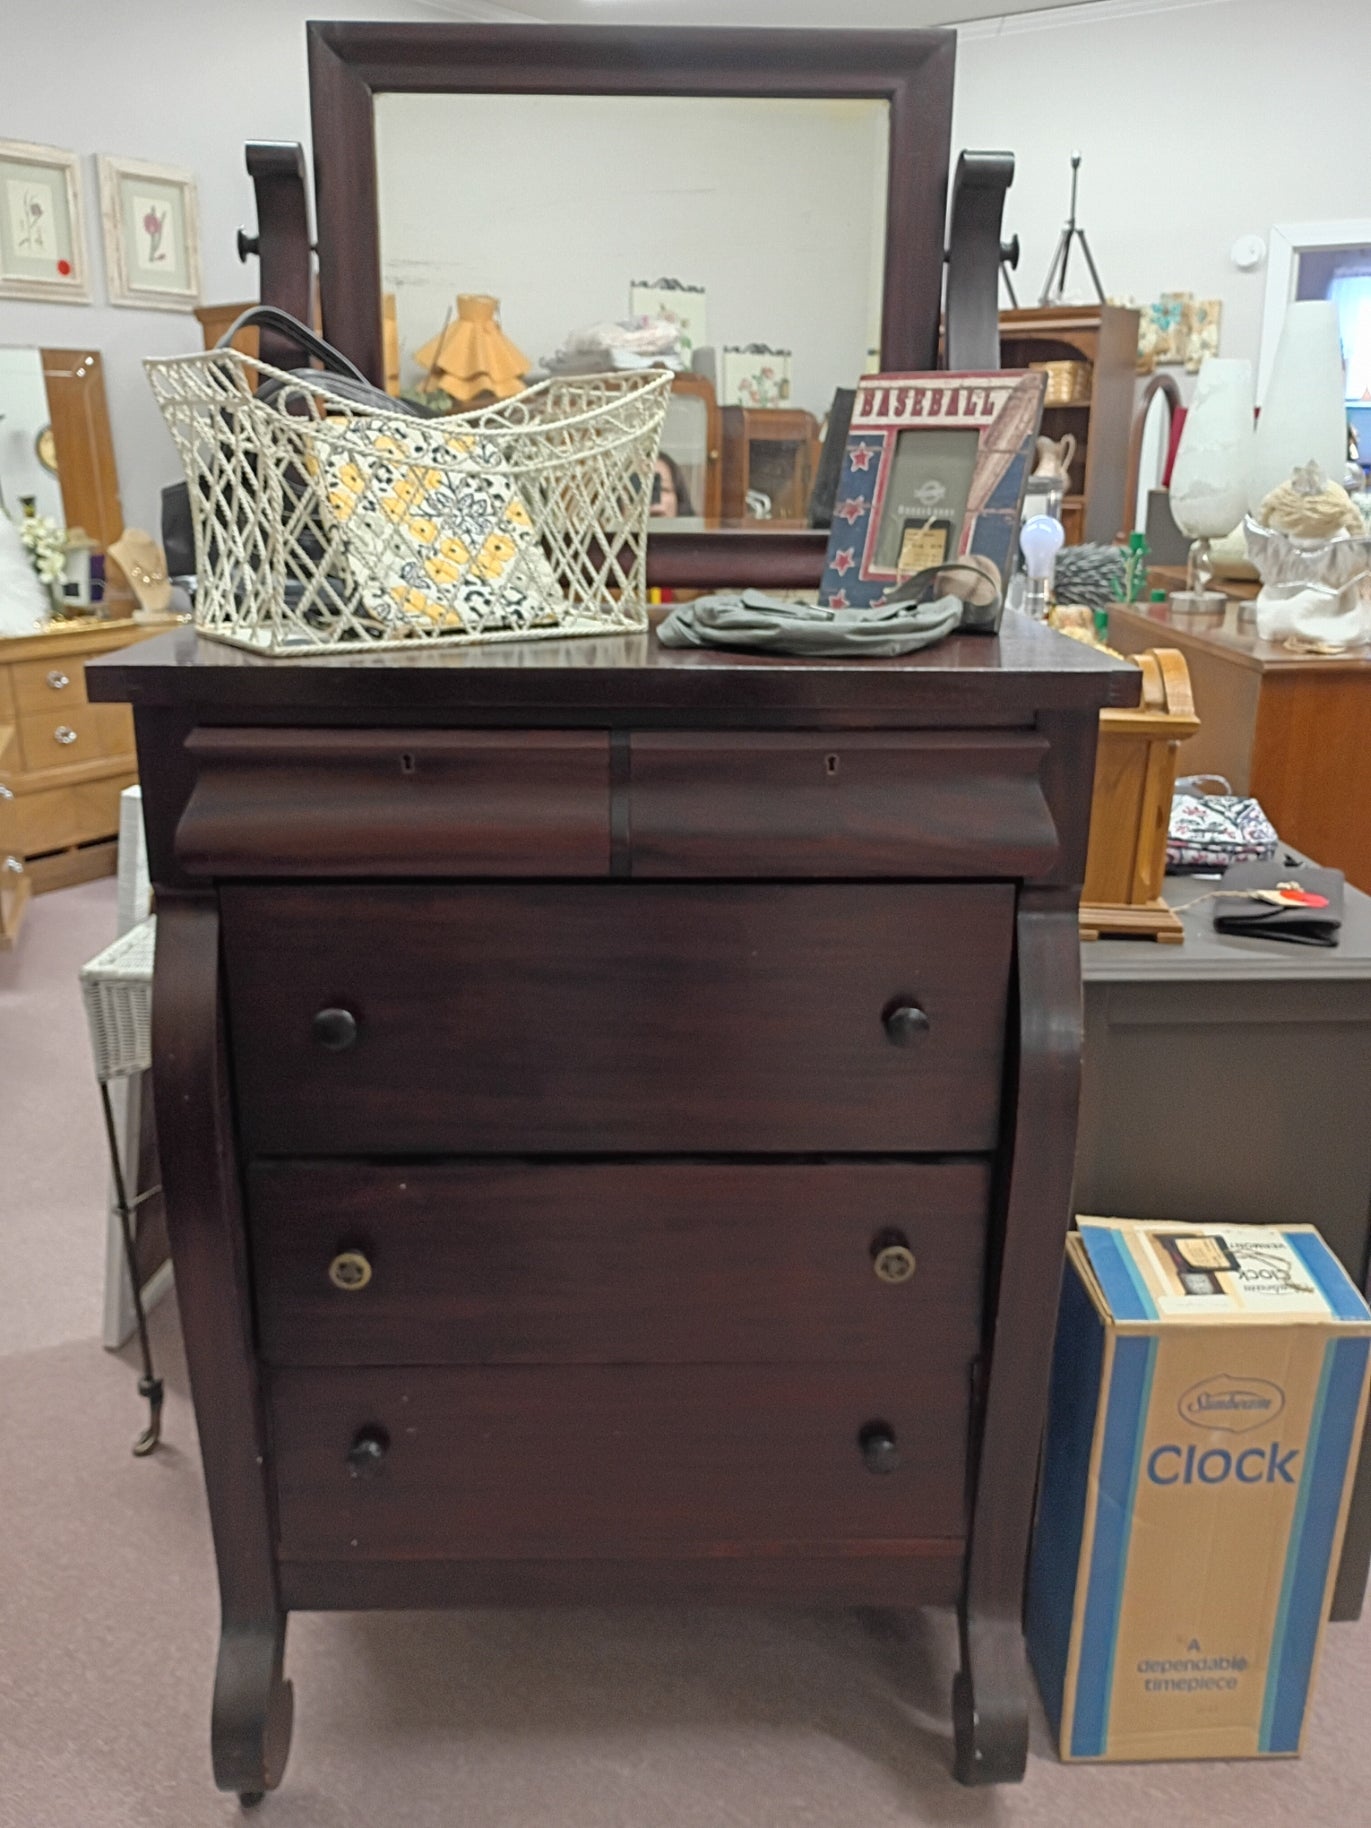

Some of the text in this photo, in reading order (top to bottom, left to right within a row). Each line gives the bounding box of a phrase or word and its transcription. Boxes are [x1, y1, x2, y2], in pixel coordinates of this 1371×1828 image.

[860, 387, 996, 417] BASEBALL
[1238, 1268, 1291, 1282] Clock
[1146, 1442, 1299, 1485] Clock
[1187, 1638, 1200, 1651] A
[1137, 1656, 1248, 1674] dependable
[1145, 1677, 1237, 1692] timepiece
